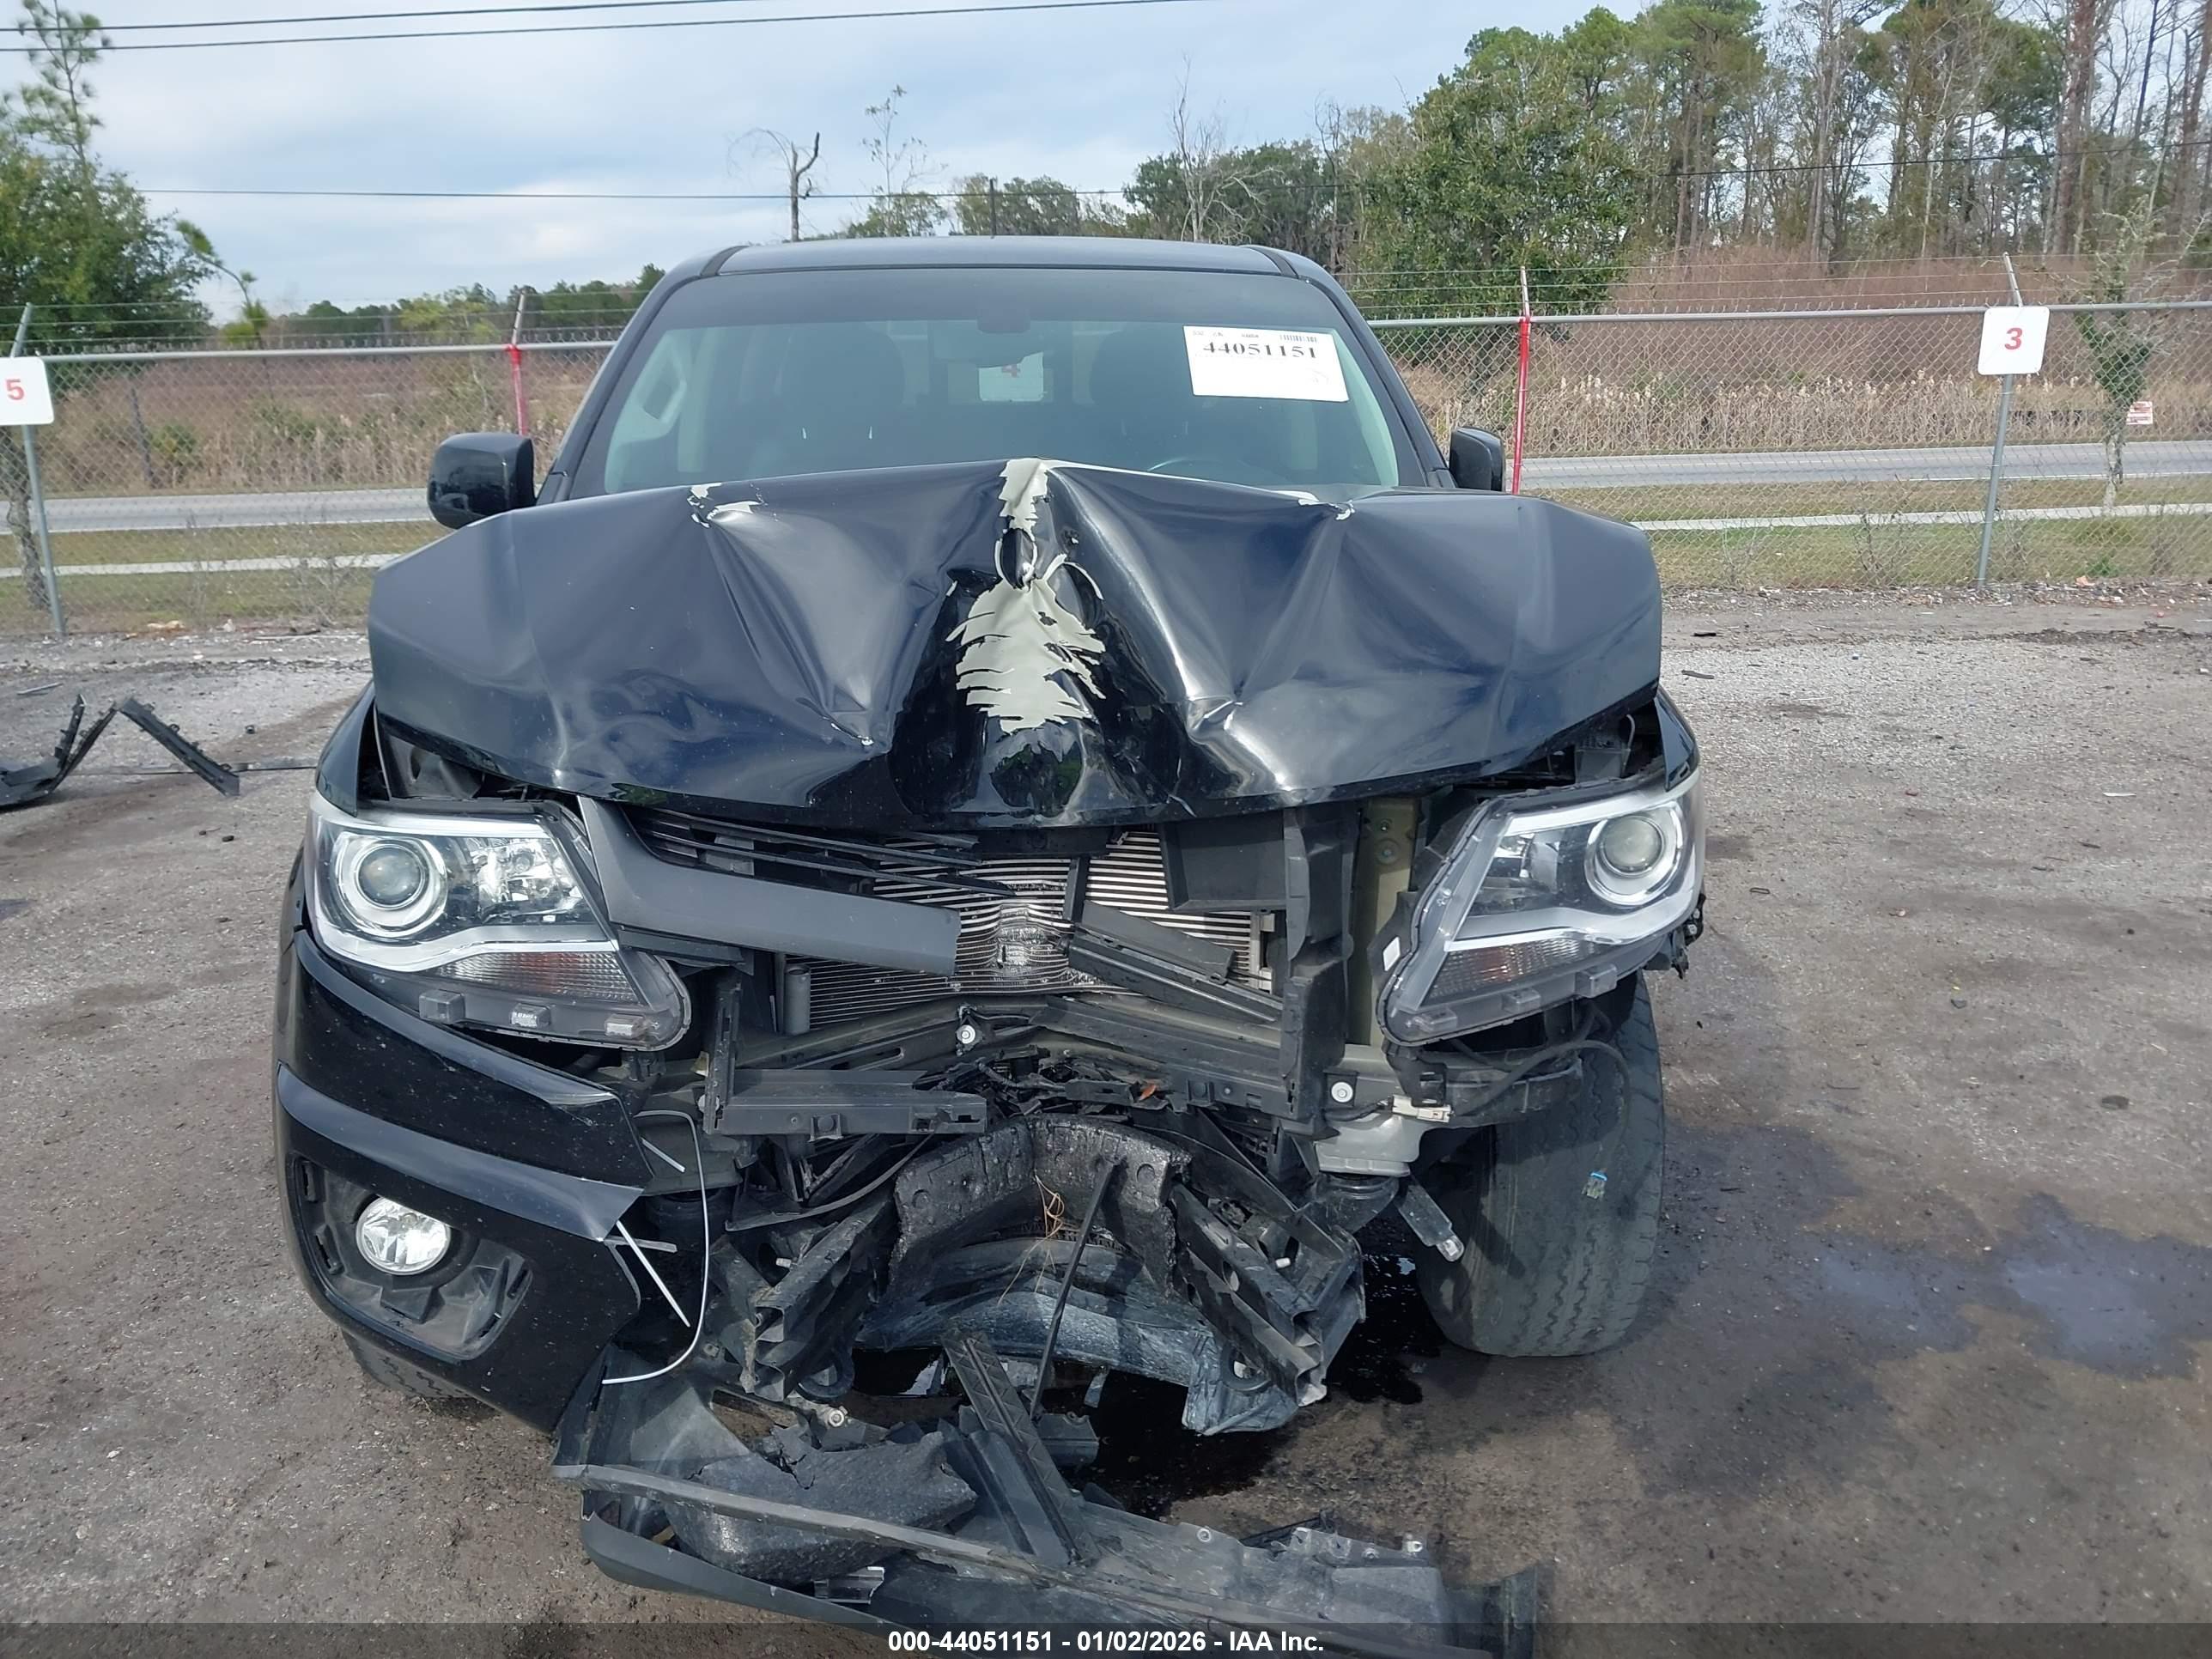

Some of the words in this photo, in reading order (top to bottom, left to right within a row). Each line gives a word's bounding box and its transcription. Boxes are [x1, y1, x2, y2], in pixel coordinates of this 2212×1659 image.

[2003, 327, 2024, 350] 3
[1203, 342, 1316, 358] 44051151
[5, 379, 25, 401] 5
